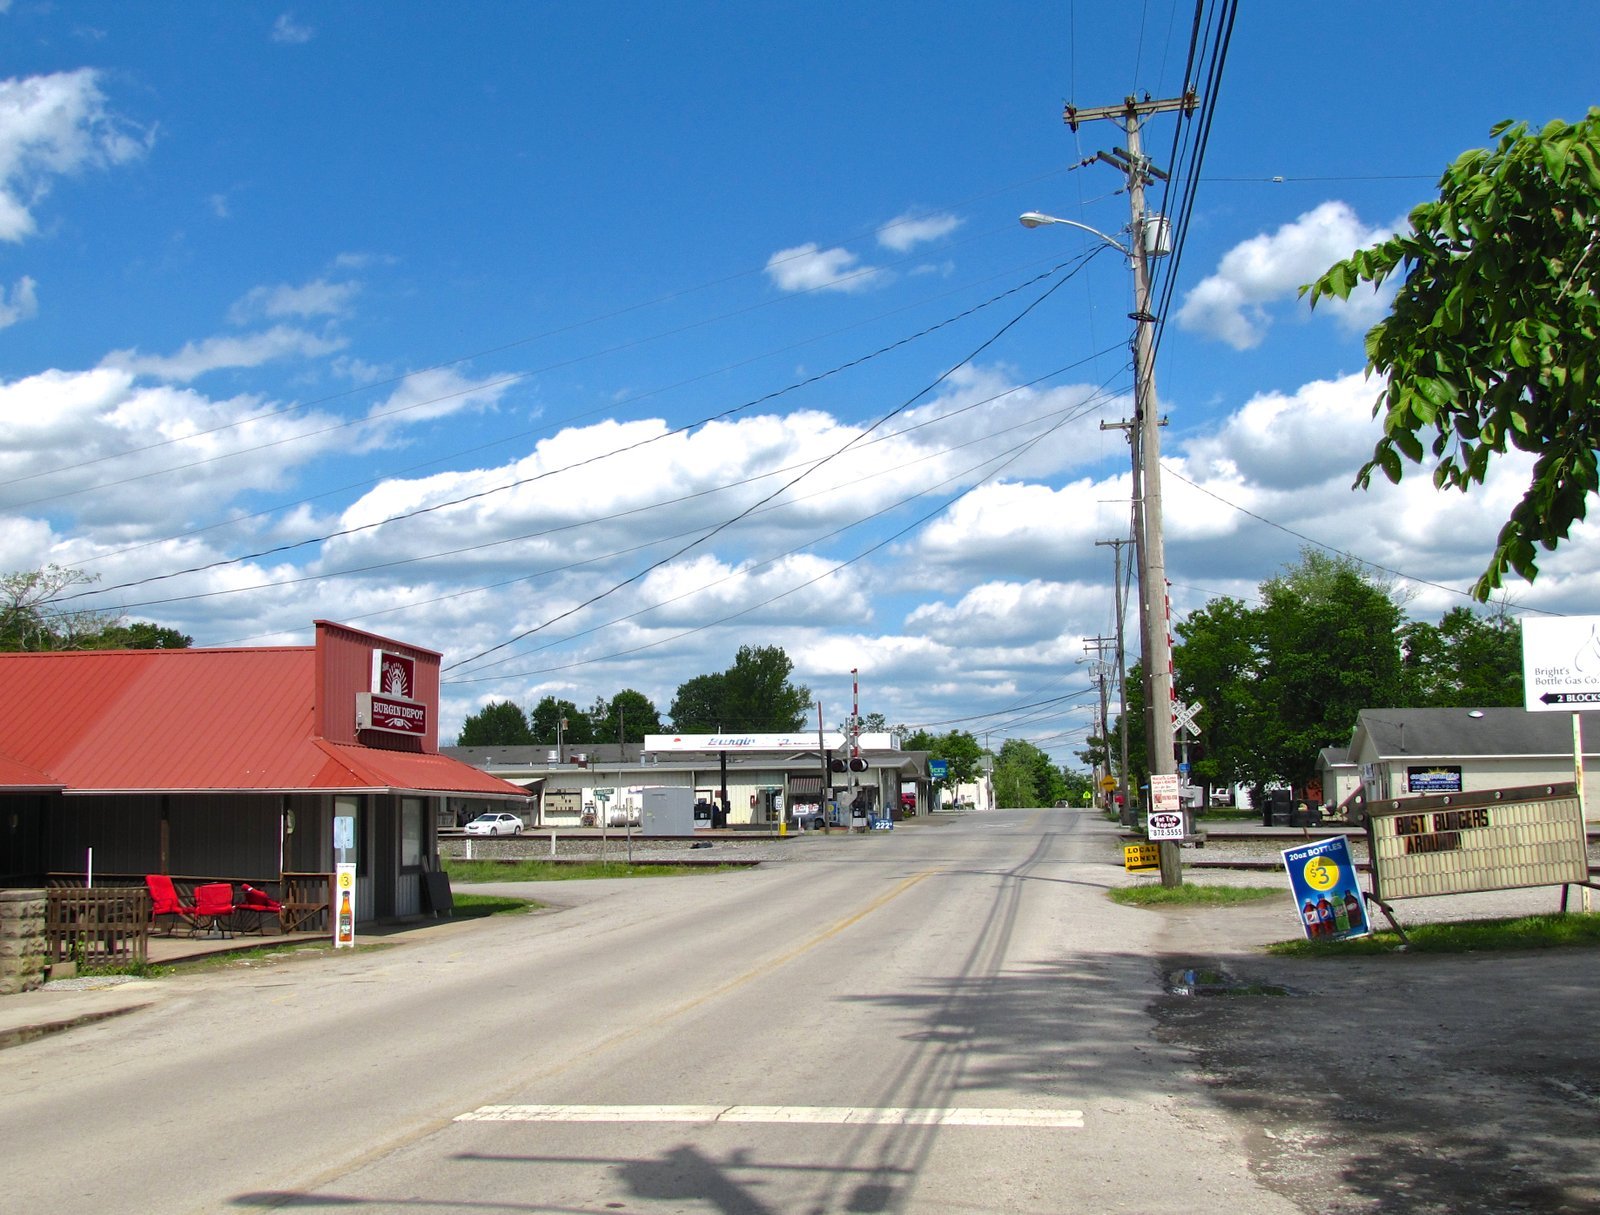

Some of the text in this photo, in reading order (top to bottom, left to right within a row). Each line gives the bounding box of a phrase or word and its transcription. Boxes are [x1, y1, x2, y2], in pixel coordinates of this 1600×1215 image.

[1534, 667, 1570, 678] Bright's
[1535, 676, 1600, 685] Bottle Gas Co.
[1556, 694, 1564, 703] 2
[373, 702, 424, 720] BURGIN DEPOT
[1172, 703, 1201, 730] ROSSING
[1186, 719, 1200, 735] ROAD
[1397, 808, 1488, 836] BST BUGERS
[1127, 845, 1156, 854] LOCAL
[1289, 842, 1343, 861] 20oz BOTTLES
[1127, 854, 1158, 862] HONEY
